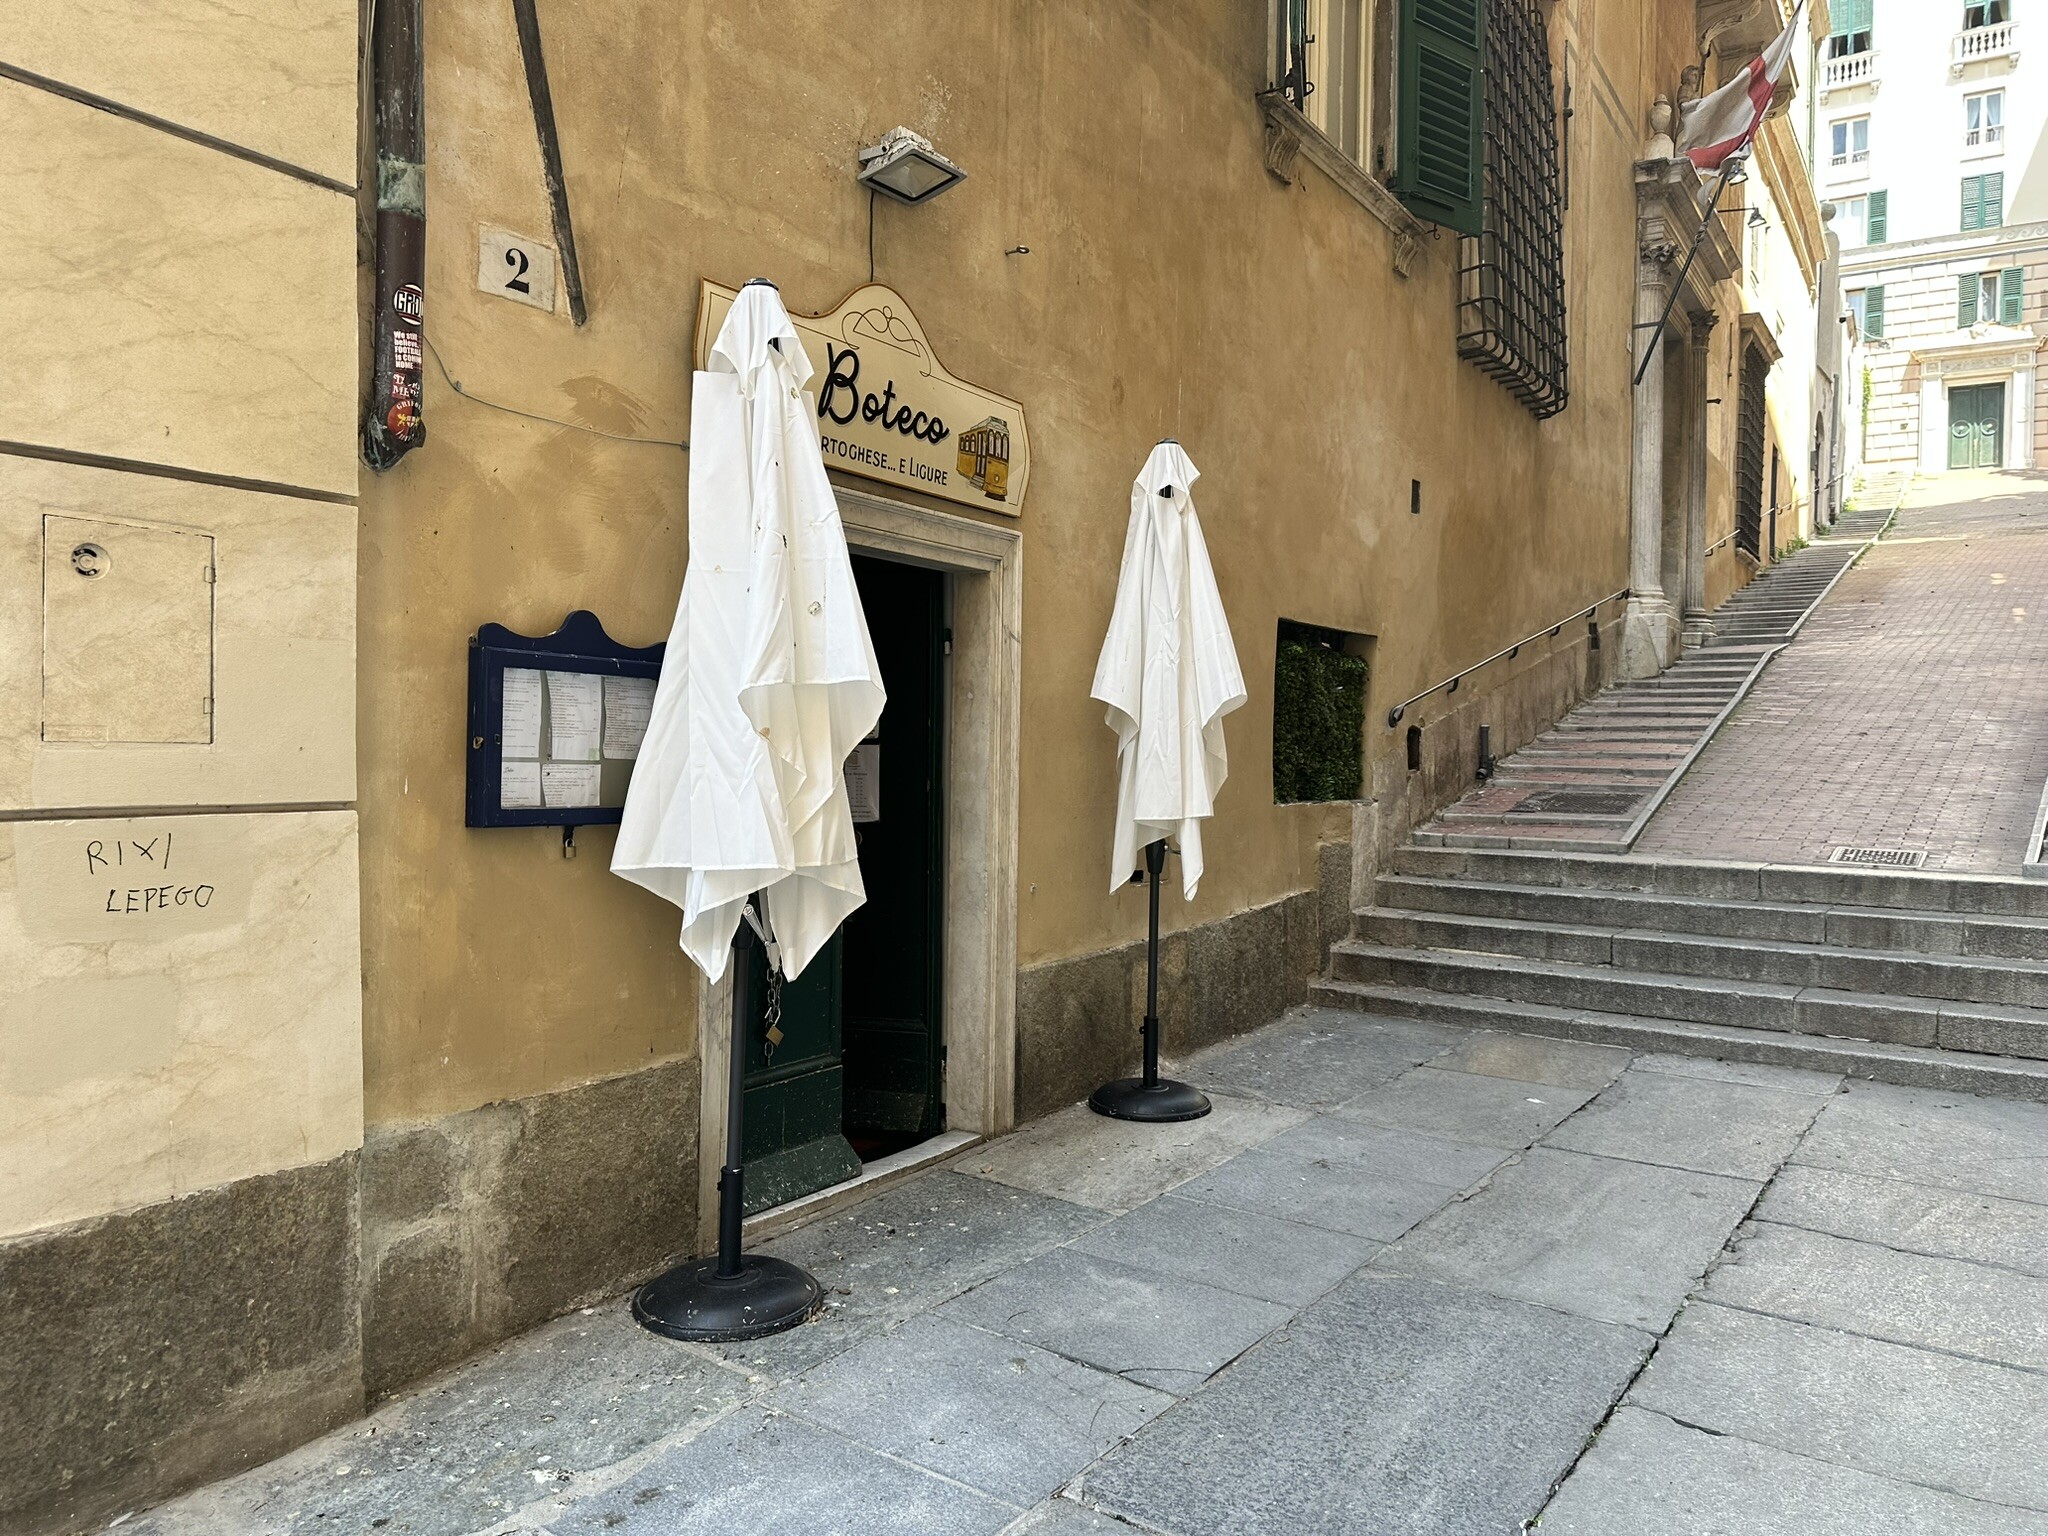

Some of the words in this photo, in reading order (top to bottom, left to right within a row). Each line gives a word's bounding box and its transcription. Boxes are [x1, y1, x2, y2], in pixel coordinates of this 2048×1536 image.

[505, 248, 529, 294] 2
[395, 361, 414, 369] HOME
[818, 342, 949, 444] Boteco
[821, 435, 896, 472] RTOGHESE...
[899, 458, 906, 473] E
[106, 885, 214, 914] LEPEGO
